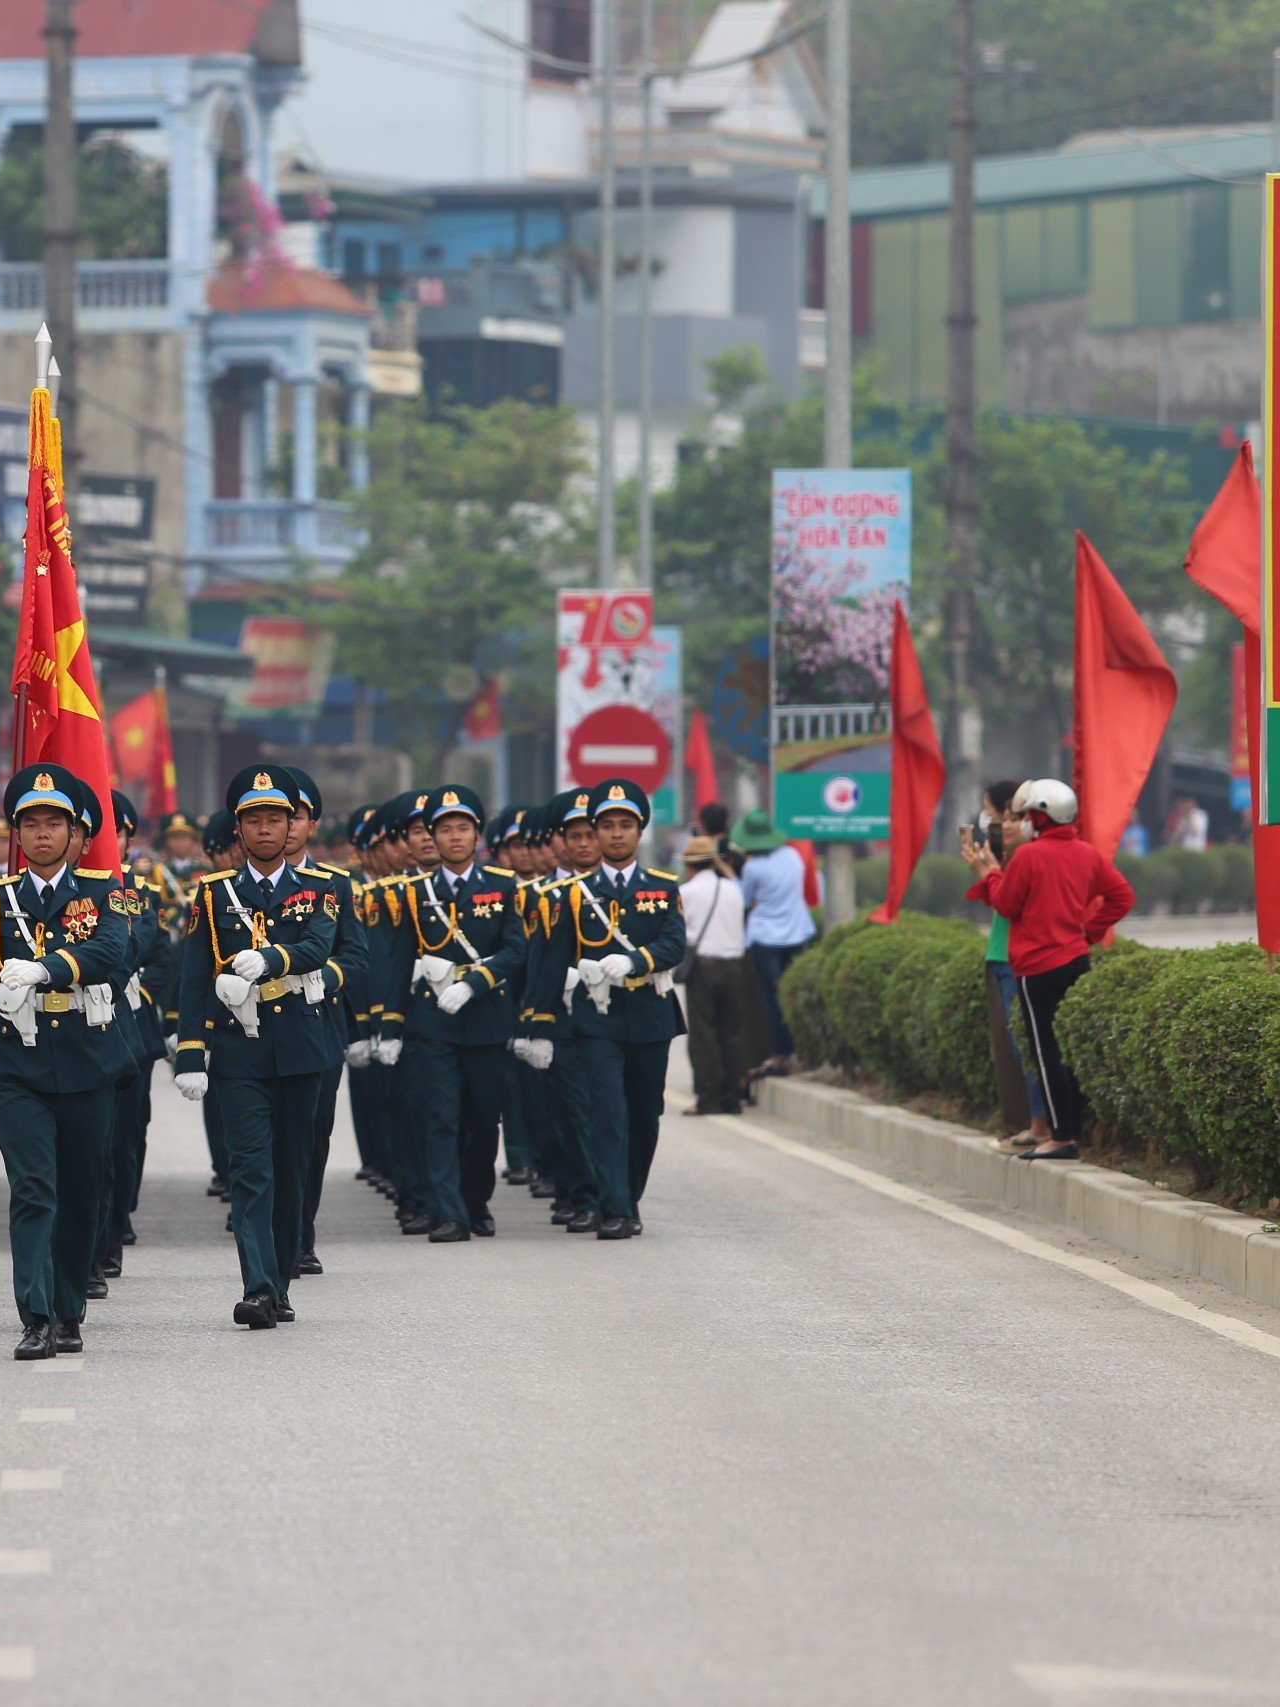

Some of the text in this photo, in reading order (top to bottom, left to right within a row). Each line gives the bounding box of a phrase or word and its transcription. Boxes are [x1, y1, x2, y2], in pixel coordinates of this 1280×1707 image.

[786, 493, 826, 517] CON
[798, 526, 886, 549] HOA BAN
